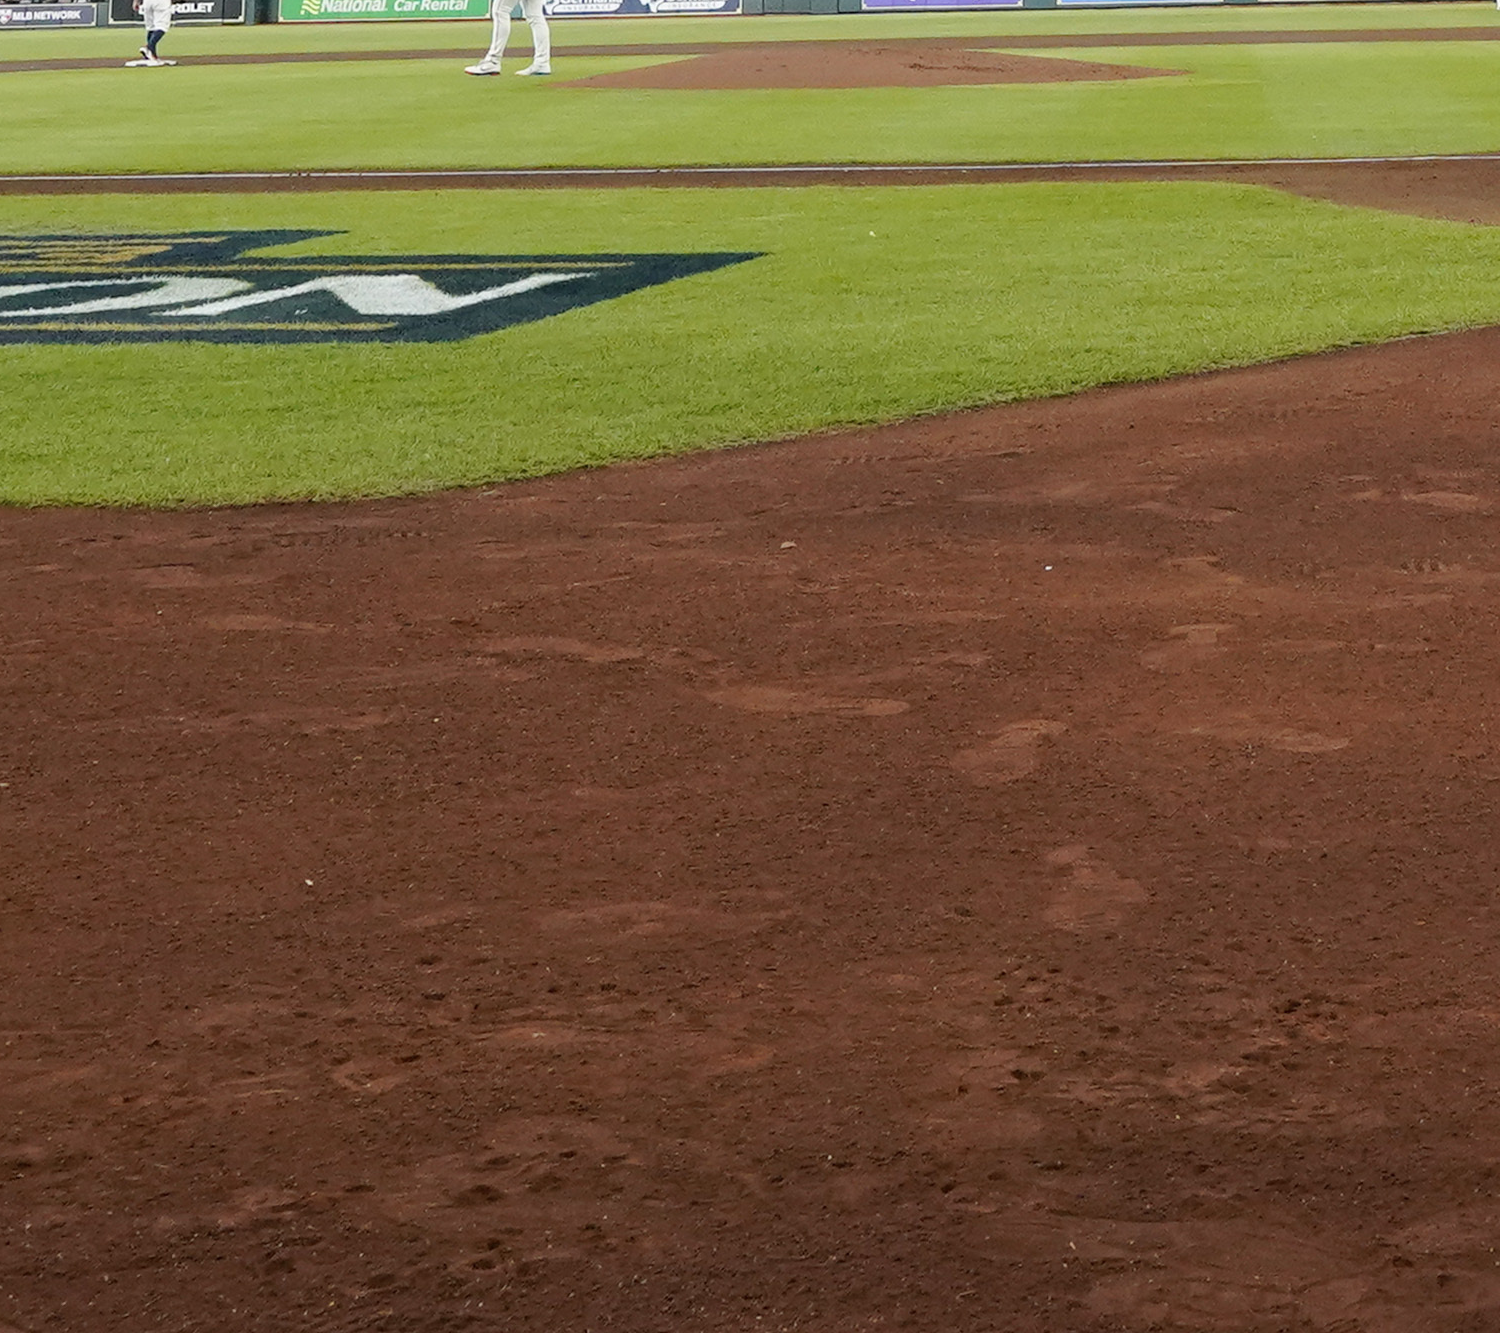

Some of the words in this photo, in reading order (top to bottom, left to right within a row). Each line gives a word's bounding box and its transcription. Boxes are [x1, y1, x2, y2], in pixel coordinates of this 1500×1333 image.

[394, 0, 420, 12] Car
[12, 11, 33, 22] MLB
[34, 9, 81, 21] NETWORK
